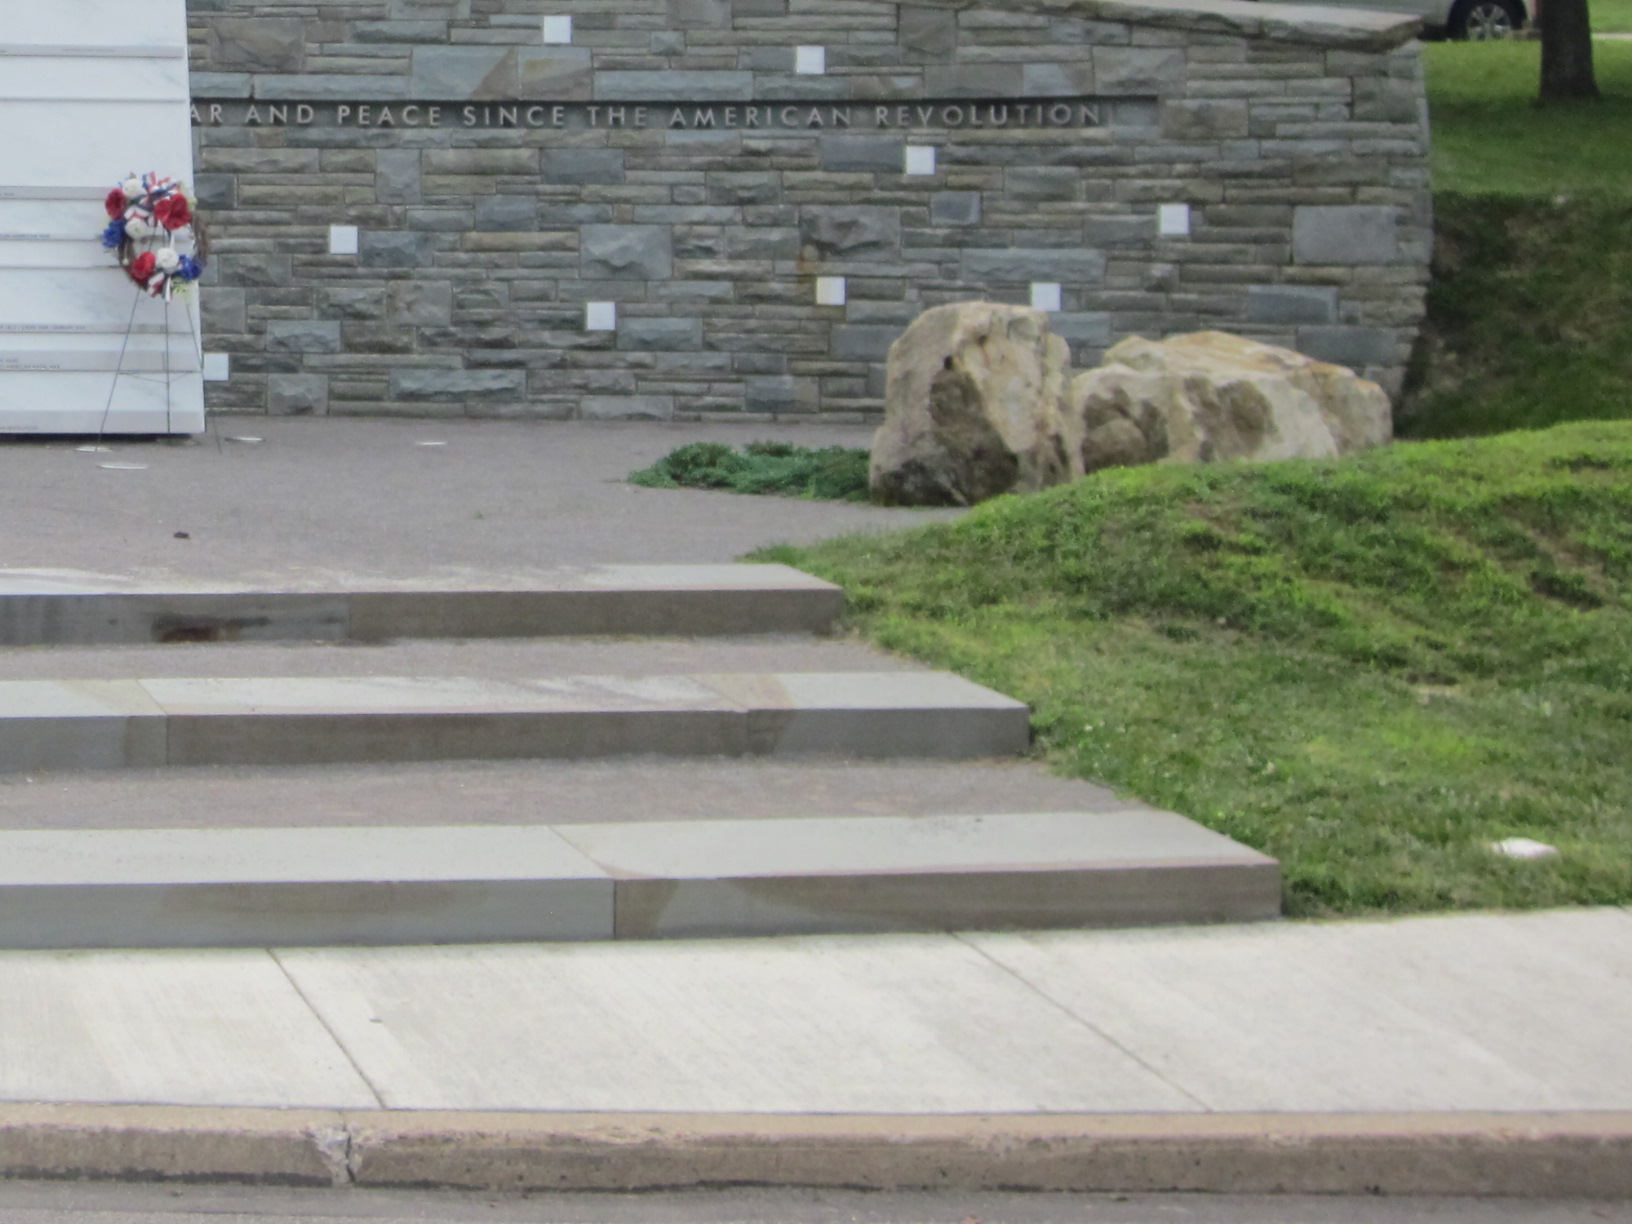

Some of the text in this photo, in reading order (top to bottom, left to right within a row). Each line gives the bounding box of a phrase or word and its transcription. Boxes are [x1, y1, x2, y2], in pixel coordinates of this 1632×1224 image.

[191, 105, 224, 124] AR
[244, 104, 314, 124] AND
[337, 105, 442, 126] PEACE
[463, 106, 565, 126] SINCE
[586, 107, 647, 126] THE
[670, 106, 851, 126] AMERICAN
[875, 105, 1101, 126] REVOLUTION
